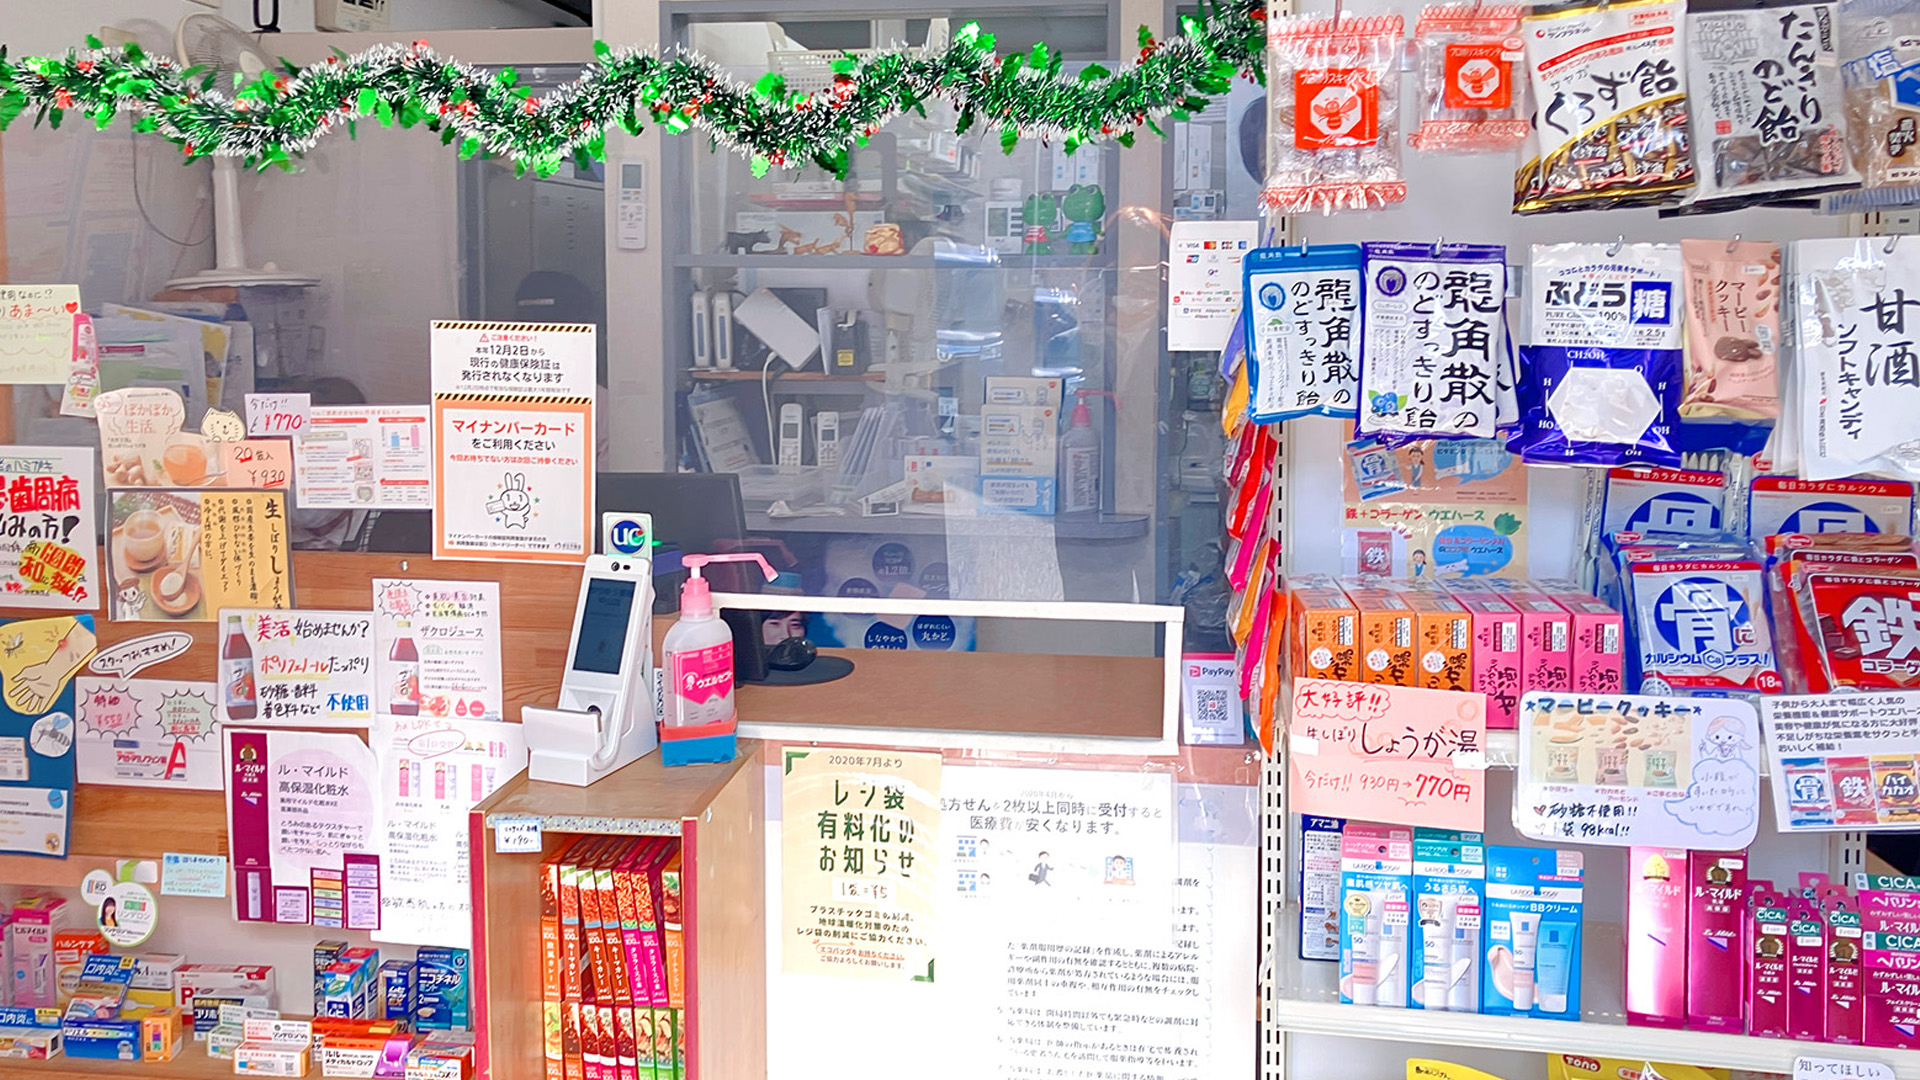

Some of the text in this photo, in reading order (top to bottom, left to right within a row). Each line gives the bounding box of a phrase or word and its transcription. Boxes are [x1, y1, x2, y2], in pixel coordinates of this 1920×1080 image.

[1779, 11, 1822, 124] たんきり
[1545, 58, 1678, 135] くろず飴
[1752, 60, 1801, 144] のど飴
[1715, 280, 1730, 331] クッキー
[1731, 281, 1746, 332] マービー
[1291, 281, 1320, 406] のどすっきり飴
[1861, 289, 1920, 388] 甘酒
[1404, 271, 1443, 429] のどすっきり飴
[1440, 271, 1500, 428] 龍角散の
[470, 357, 561, 370] 現行の健康保険証は
[461, 370, 564, 383] 発行されなくなります
[451, 419, 576, 437] マイナンバーカード
[471, 438, 556, 451] をご利用ください
[1633, 471, 1725, 486] 毎日カラダにカルシウ
[1778, 481, 1888, 493] 毎日カラダにカルシウム
[1429, 510, 1485, 521] ウエハース
[257, 615, 370, 642] 美活 始めませんか?
[420, 625, 484, 638] ザクロジュース
[868, 634, 905, 643] しなやかで
[260, 656, 370, 674] ポリフェノールたっぷり
[1202, 667, 1235, 677] PayPay
[326, 693, 370, 712] 不使用
[1303, 688, 1381, 713] 大好評!!
[1772, 697, 1905, 709] 子供から大人まで幅広く人気の
[262, 702, 321, 718] 着色料など
[1537, 698, 1692, 718] マービークッキー
[164, 742, 186, 780] A
[829, 755, 903, 768] 2020年7月より
[278, 764, 348, 778] ル・マイルド
[1305, 770, 1352, 792] 今だけ!!
[1886, 775, 1908, 785] ハイ
[279, 781, 350, 797] 高保湿化粧水
[1882, 785, 1915, 796] カカオ
[1549, 802, 1638, 818] 砂糖不使用!!
[387, 820, 436, 829] ル・マイルド
[818, 810, 915, 844] 有料化の
[1310, 818, 1340, 828] アマニ油
[819, 845, 915, 878] お知らせ
[1424, 883, 1475, 894] うるさら肌へ
[1695, 887, 1742, 900] ル・マイルド
[1530, 902, 1578, 914] BBクリーム
[1756, 910, 1781, 921] CICA
[1830, 913, 1856, 924] CICA
[15, 926, 48, 935] ヒルマイルド
[1791, 923, 1815, 934] CICA
[56, 940, 95, 948] ハルンケア
[85, 962, 121, 976] 口内炎に
[567, 942, 577, 983] キーマカレー
[593, 945, 605, 986] キーマカレー
[612, 946, 624, 987] キーマカレー
[419, 973, 462, 985] ニコチネル
[420, 984, 438, 992] ミント
[64, 1027, 90, 1037] ドリエル
[325, 1059, 374, 1067] メディカルドロップ
[1565, 1056, 1598, 1071] TONO
[1798, 1060, 1881, 1077] 知ってほしい
